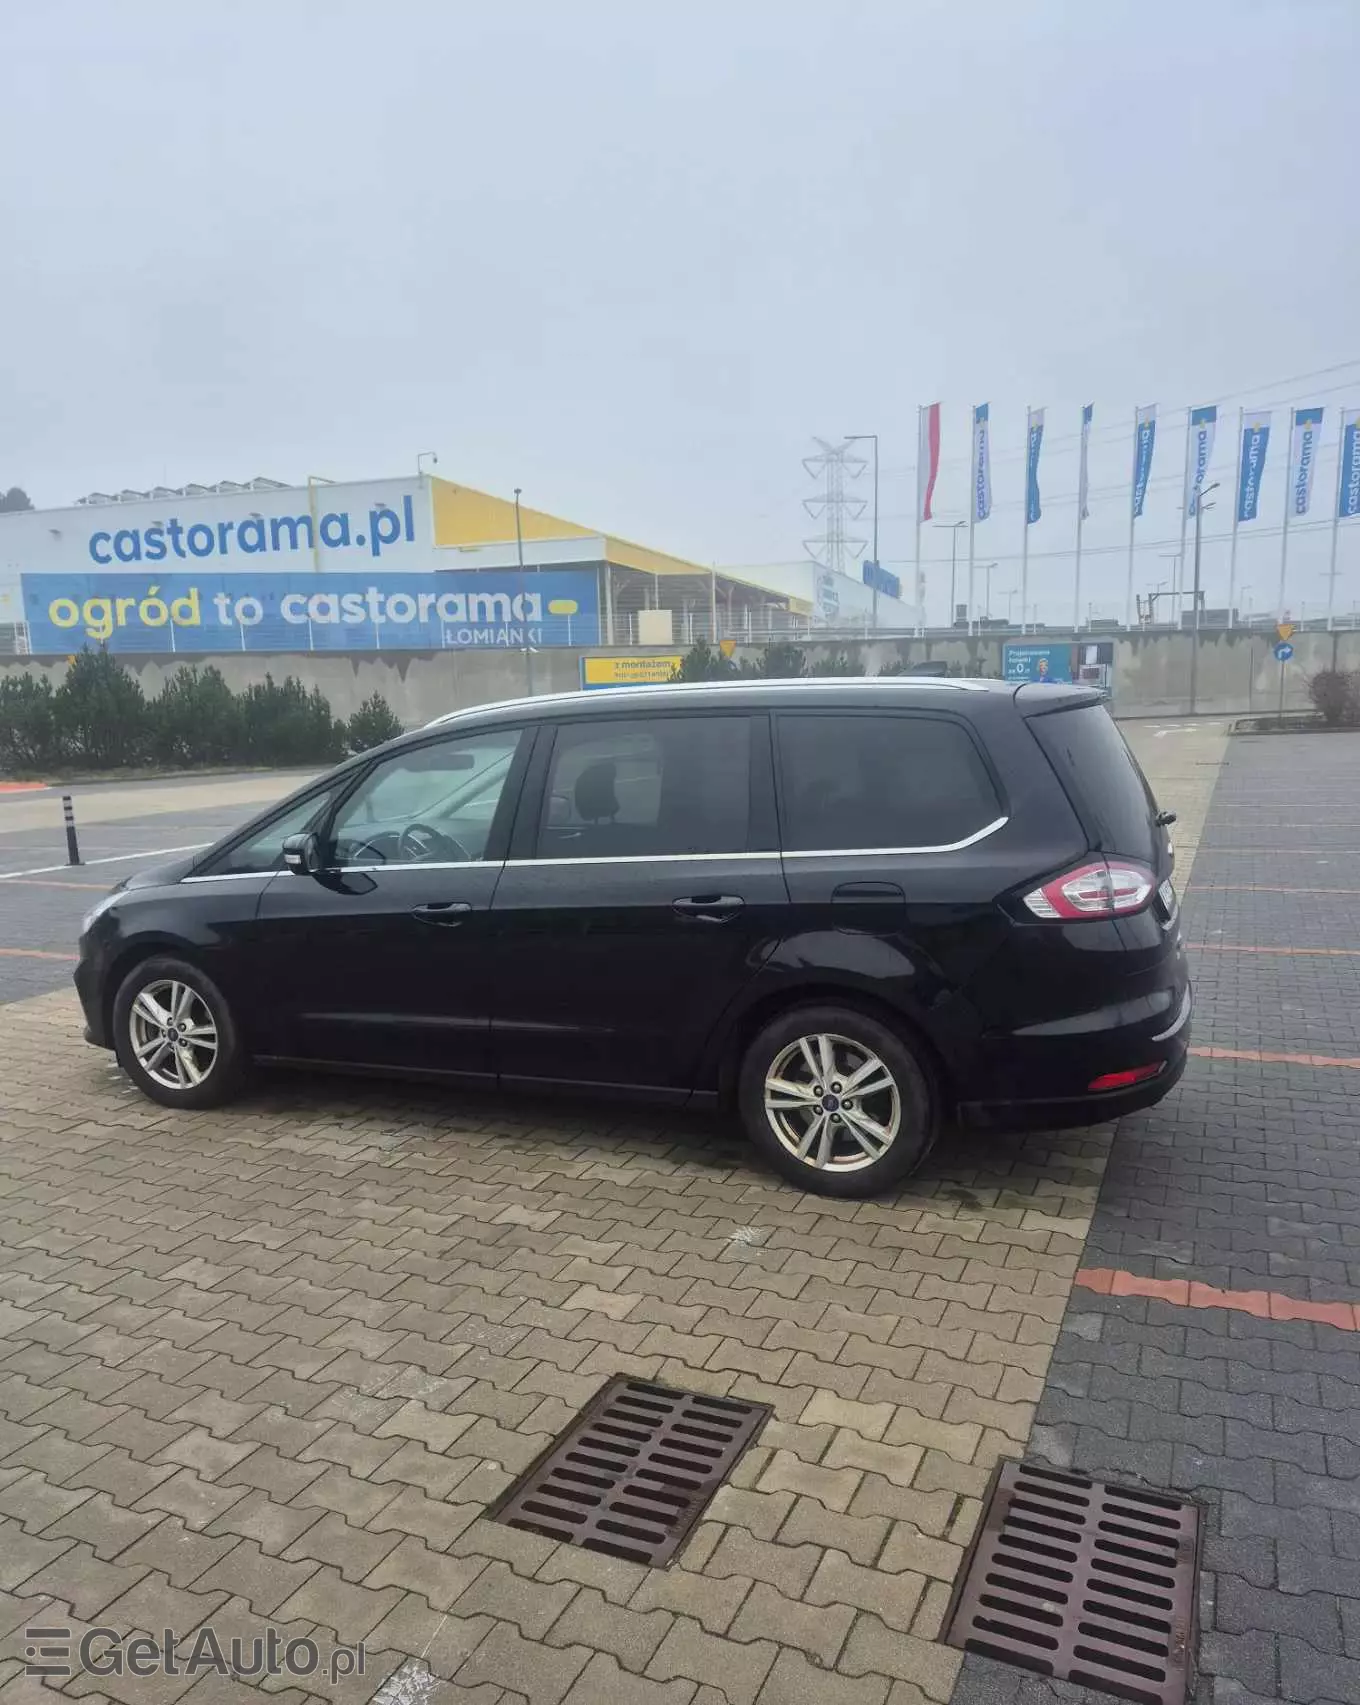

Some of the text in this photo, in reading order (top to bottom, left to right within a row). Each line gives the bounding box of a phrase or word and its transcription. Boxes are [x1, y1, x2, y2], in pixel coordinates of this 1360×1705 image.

[1296, 430, 1312, 514] castorama
[89, 495, 415, 564] castorama.pl
[48, 584, 542, 640] ogród to castorama
